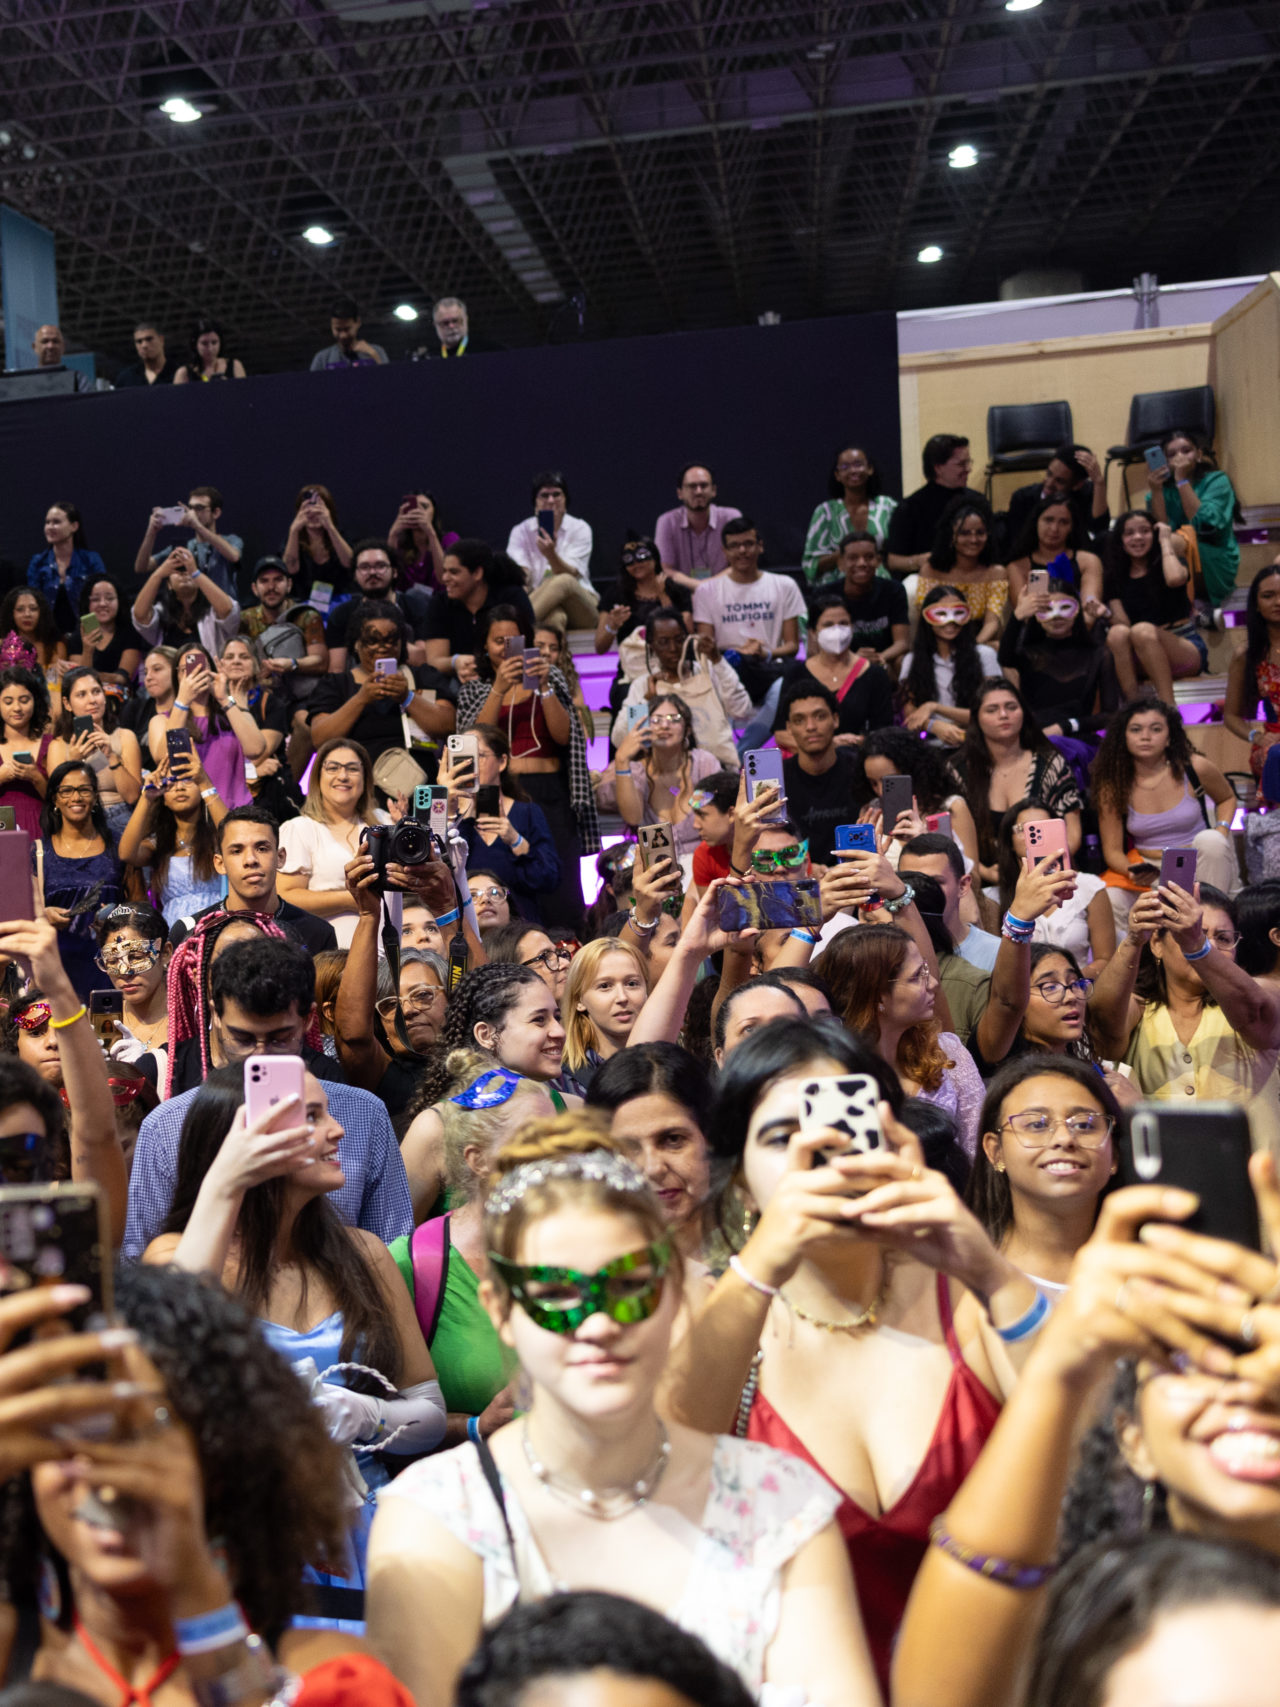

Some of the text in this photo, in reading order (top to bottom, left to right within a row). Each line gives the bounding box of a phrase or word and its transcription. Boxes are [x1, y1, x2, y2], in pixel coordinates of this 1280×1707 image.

[725, 601, 771, 613] TOMMY
[722, 612, 775, 623] HILFIGER
[451, 965, 462, 990] NIK
